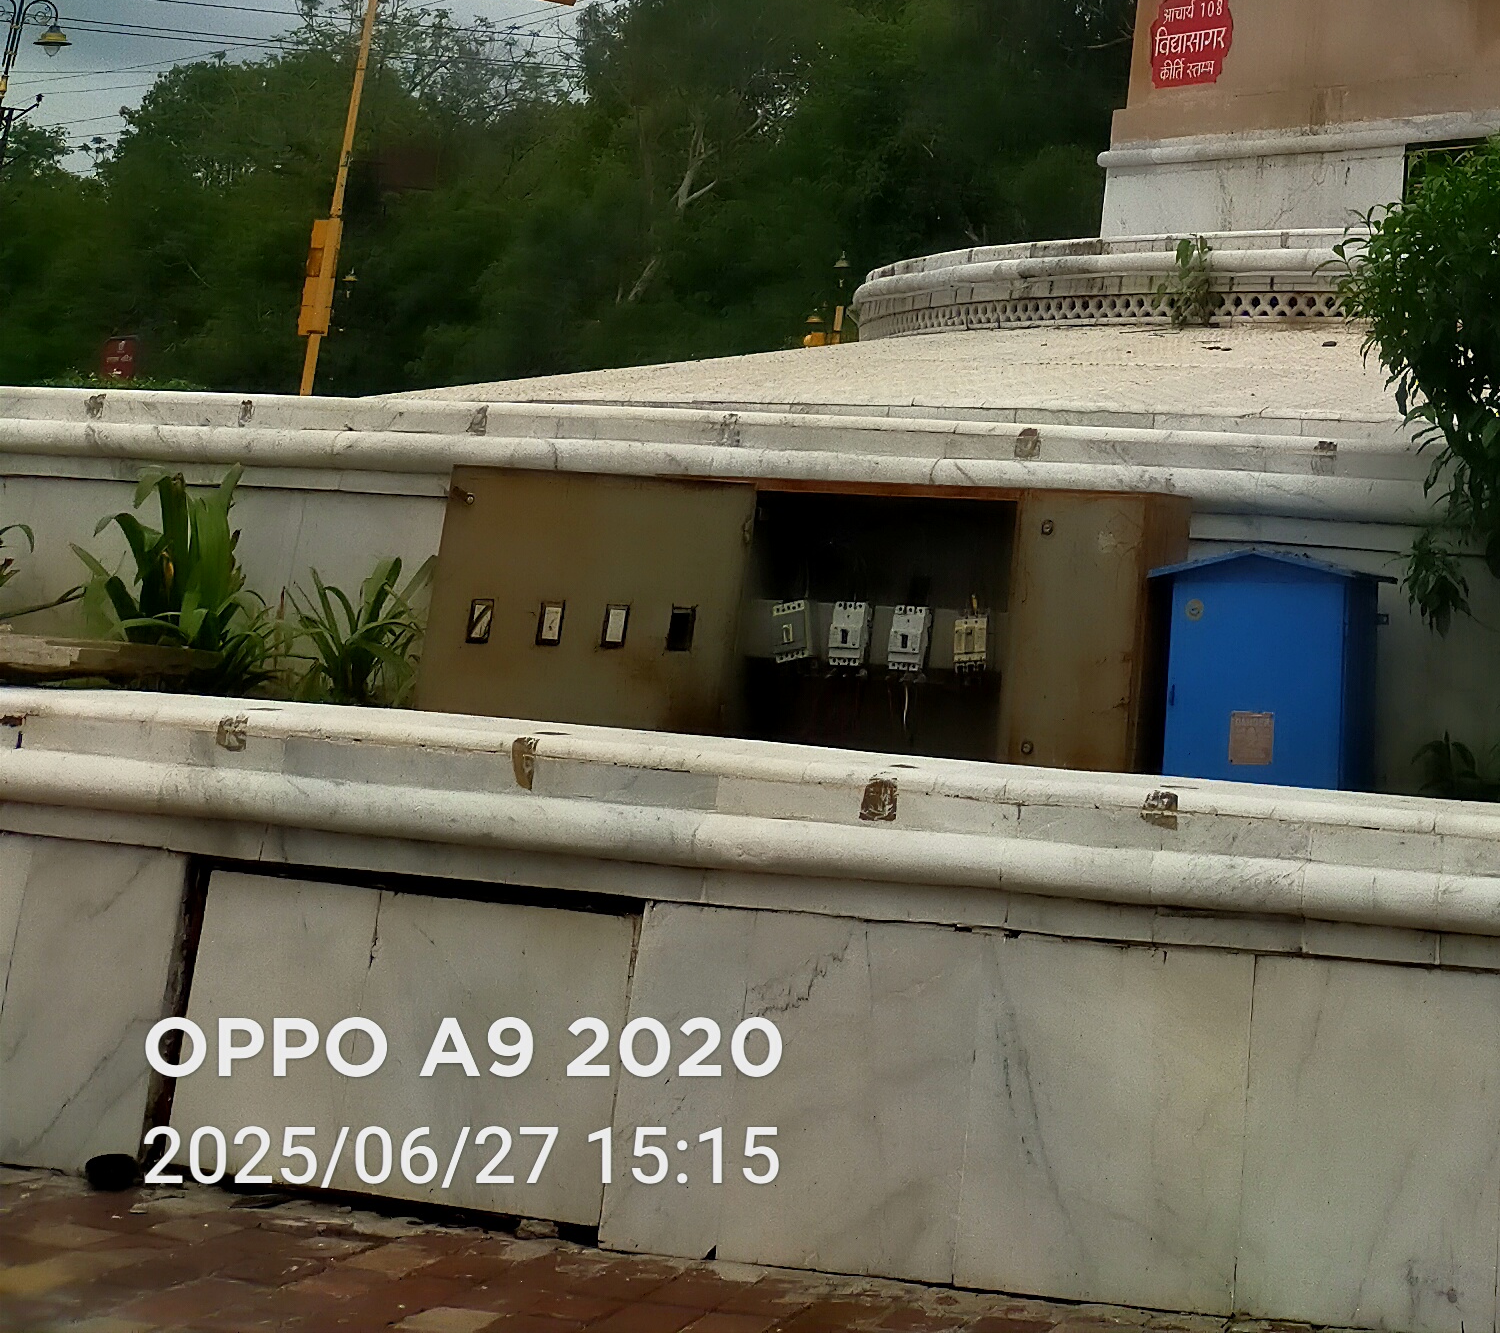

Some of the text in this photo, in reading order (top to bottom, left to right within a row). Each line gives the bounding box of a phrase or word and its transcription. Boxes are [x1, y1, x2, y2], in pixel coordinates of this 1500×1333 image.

[1163, 0, 1223, 24] आचार्य 108
[1155, 27, 1227, 57] विद्यासागर
[1160, 58, 1215, 81] कीर्ति स्तम्भ
